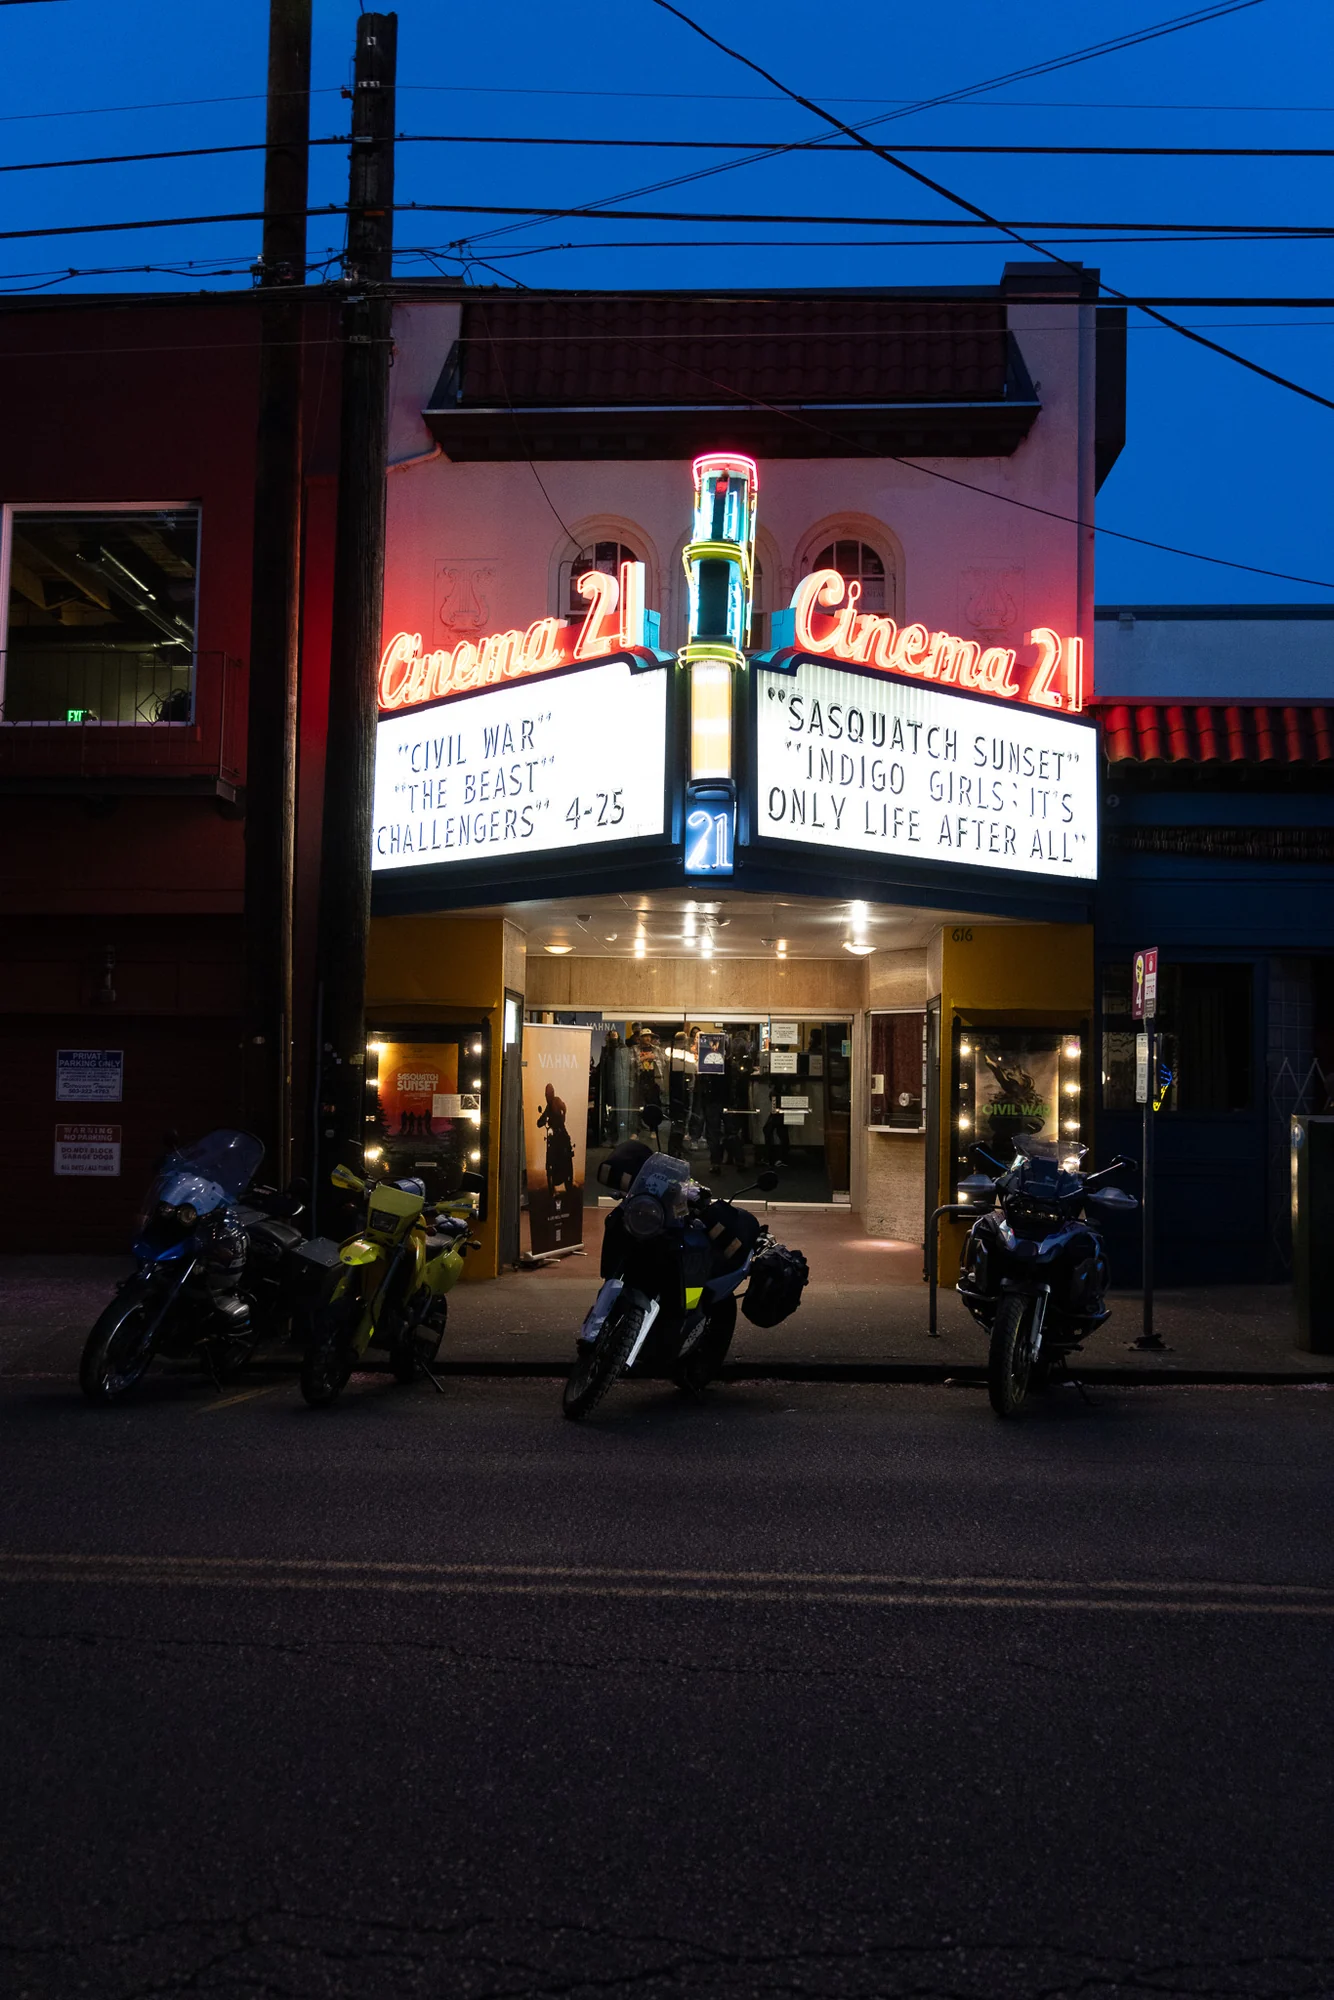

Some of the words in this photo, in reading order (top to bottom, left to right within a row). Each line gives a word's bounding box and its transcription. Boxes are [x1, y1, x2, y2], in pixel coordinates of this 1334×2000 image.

[377, 617, 567, 709] Cinema
[573, 561, 645, 660] 21
[794, 568, 1020, 697] Cinema
[1024, 627, 1084, 712] 21
[398, 734, 467, 773] "CIVIL
[483, 711, 552, 759] WAR"
[767, 686, 957, 762] "SASQUATCH
[973, 736, 1080, 781] SUNSET"
[394, 779, 447, 813] "THE
[463, 755, 555, 805] BEAST"
[565, 788, 625, 831] 4-25
[784, 739, 905, 795] "INDIGO
[1030, 787, 1075, 823] IT'S
[686, 811, 733, 869] 21
[768, 786, 846, 831] ONLY
[864, 800, 921, 842] LIFE
[937, 814, 1017, 856] AFTER
[1030, 829, 1087, 863] ALL"
[952, 928, 973, 942] 616
[98, 1060, 120, 1068] ONLY
[397, 1073, 439, 1081] SASQUATCH
[397, 1081, 439, 1091] SUNSET
[64, 1127, 113, 1135] WARNING
[982, 1104, 1018, 1115] CIVIL
[1021, 1104, 1051, 1117] WAR
